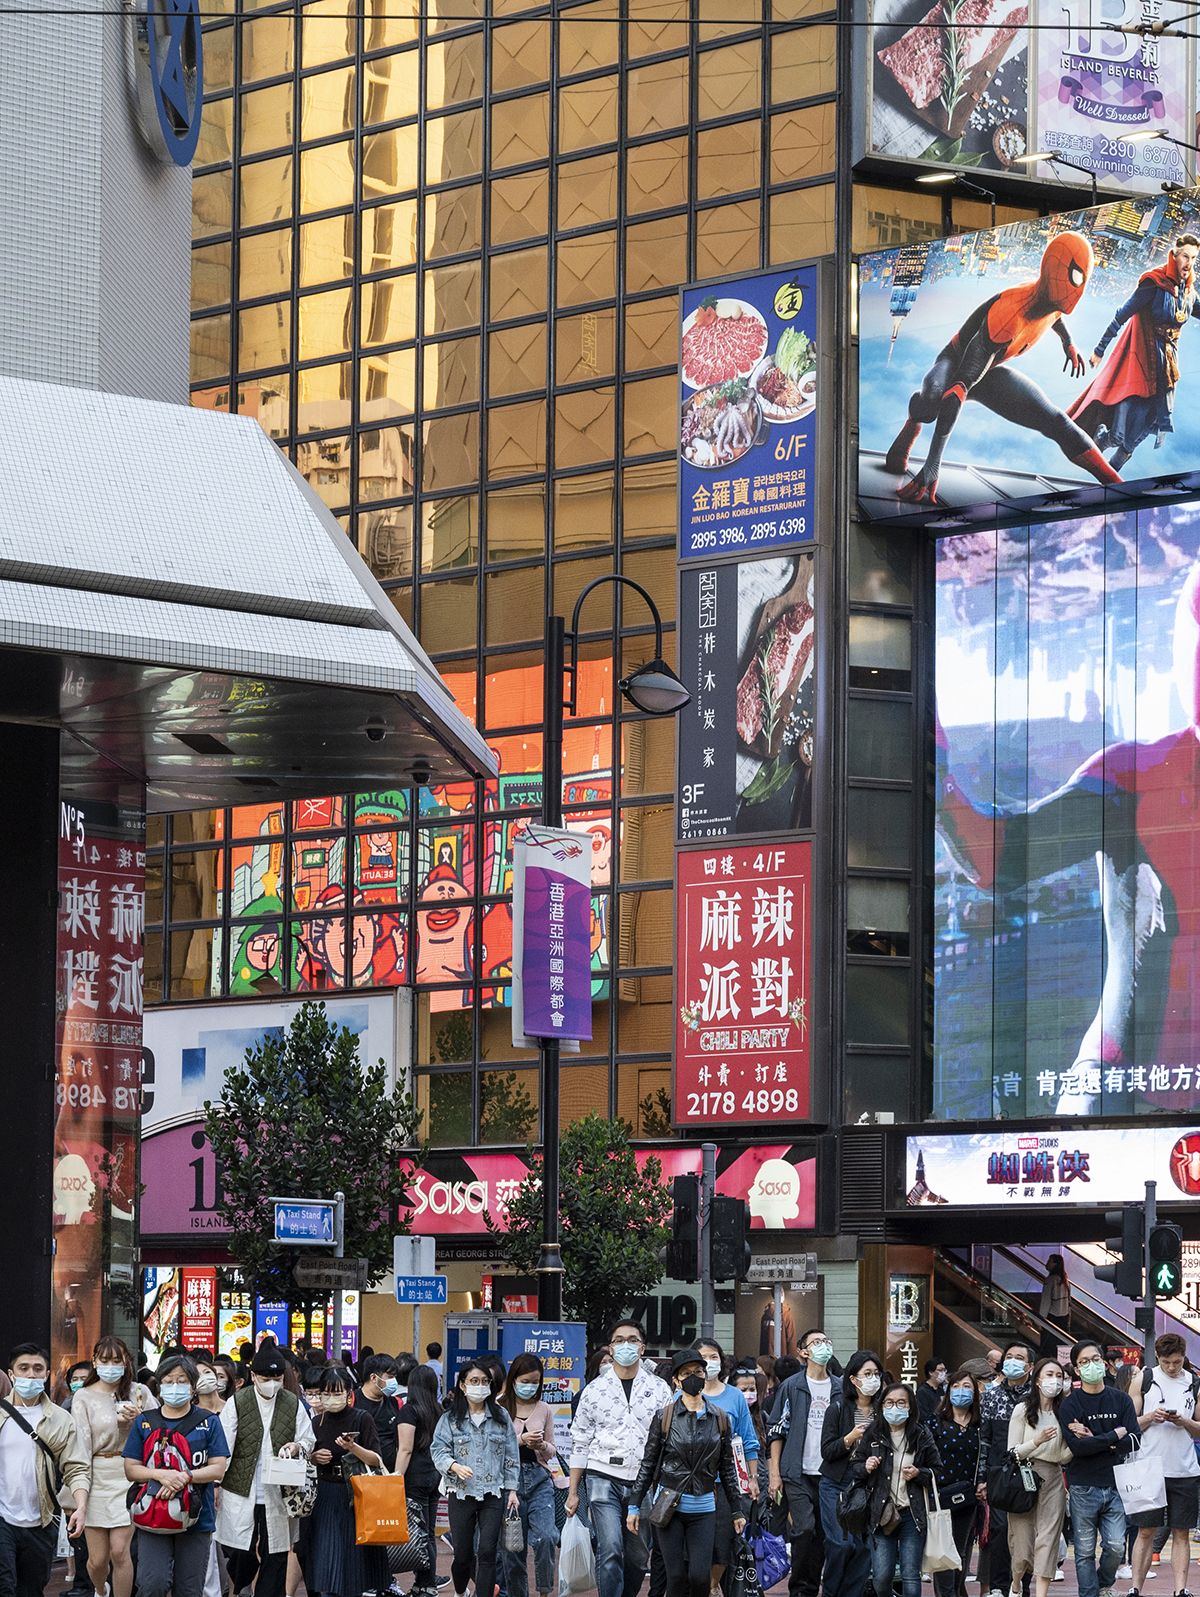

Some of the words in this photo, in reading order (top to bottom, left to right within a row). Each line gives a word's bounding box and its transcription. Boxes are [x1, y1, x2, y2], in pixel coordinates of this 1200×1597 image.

[1061, 58, 1102, 73] ISLAND
[1108, 65, 1162, 84] BEVERLEY
[1075, 95, 1103, 117] Well
[1105, 106, 1150, 121] Dressed
[1045, 131, 1093, 152] 租務查詢
[1100, 139, 1136, 159] 2890
[1143, 145, 1179, 166] 6870
[774, 434, 807, 461] 6/F
[692, 477, 750, 512] 金羅寶
[752, 483, 806, 503] 韓國料理
[691, 513, 701, 524] JIN
[702, 511, 715, 523] LUO
[716, 510, 730, 520] BAO
[732, 506, 758, 518] KOREAN
[691, 532, 717, 550] 2895
[719, 526, 748, 545] 3986,
[750, 522, 776, 540] 2895
[778, 517, 806, 536] 6398
[703, 632, 716, 768] 柞木炭家
[682, 784, 705, 804] 3F
[682, 829, 703, 838] 2619
[706, 827, 727, 836] 0868
[700, 885, 795, 952] 麻辣
[549, 882, 565, 1028] 香港亞洲國際都會
[699, 956, 794, 1022] 派對
[700, 1030, 738, 1051] CHILI
[741, 1028, 790, 1048] PARTY
[687, 1091, 736, 1116] 2178
[742, 1088, 799, 1113] 4898
[987, 1150, 1091, 1185] 蜘蛛俠
[412, 1175, 488, 1215] Sasa
[757, 1180, 791, 1196] Sasa
[1006, 1186, 1071, 1198] 不戰無歸
[287, 1209, 300, 1219] Taxi
[302, 1210, 321, 1219] Stand
[290, 1223, 317, 1235] 的士站
[302, 1261, 316, 1269] East
[319, 1260, 336, 1270] Point
[339, 1262, 357, 1270] Road
[756, 1258, 771, 1266] East
[772, 1257, 788, 1265] Point
[789, 1256, 806, 1265] Road
[405, 1279, 417, 1287] Taxi
[418, 1279, 436, 1287] Stand
[768, 1268, 794, 1279] 東角道
[409, 1289, 433, 1301] 的士站
[266, 1316, 278, 1325] 6/F
[524, 1339, 565, 1353] 開戶送
[1125, 1484, 1142, 1493] Dior
